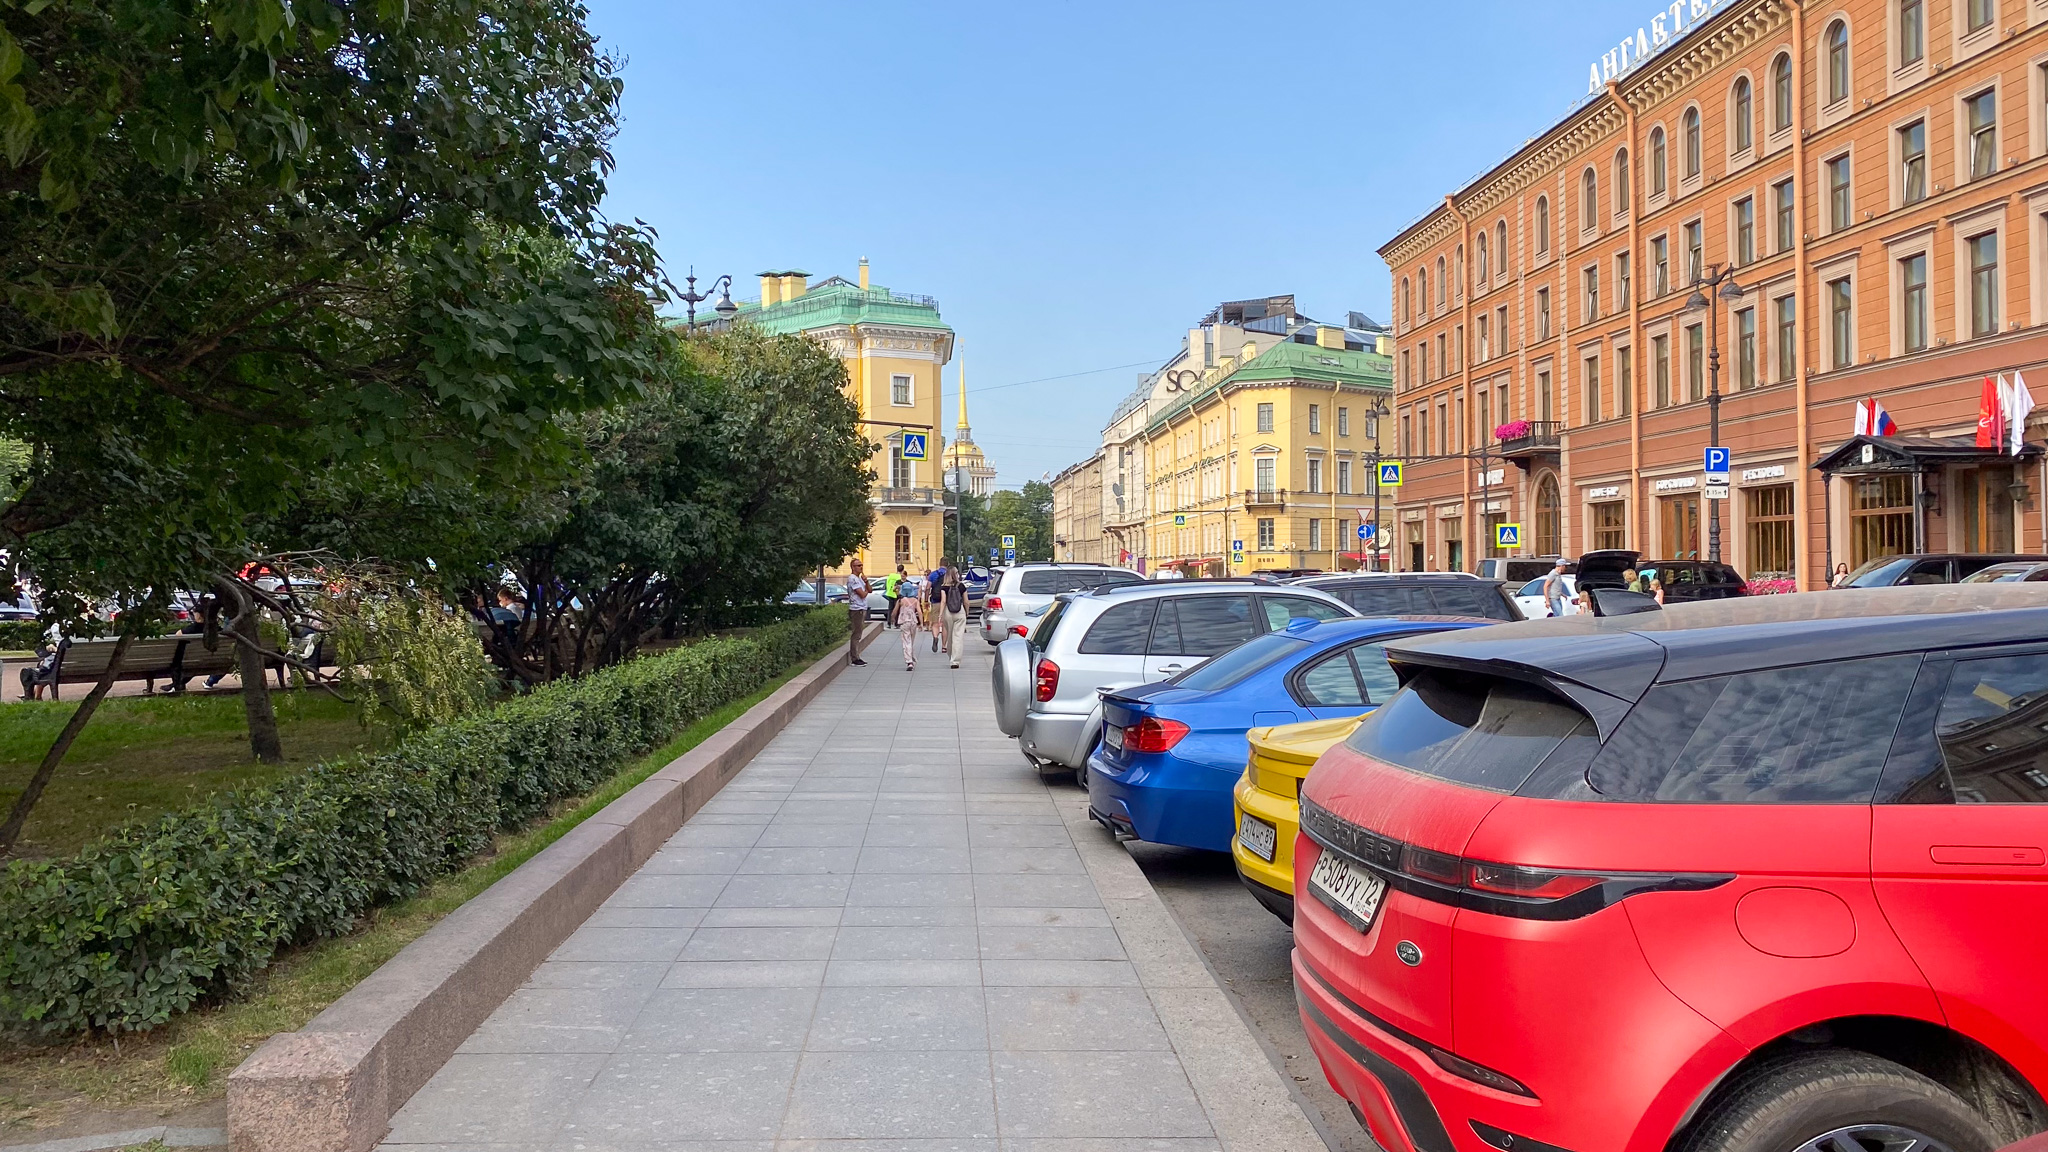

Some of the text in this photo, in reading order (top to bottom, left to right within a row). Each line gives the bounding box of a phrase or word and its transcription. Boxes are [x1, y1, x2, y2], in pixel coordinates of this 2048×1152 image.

[1588, 0, 1718, 94] АНГЛЕТЕ
[1710, 450, 1724, 470] P
[1299, 804, 1392, 861] ANGE ROVER
[1362, 876, 1379, 906] 72
